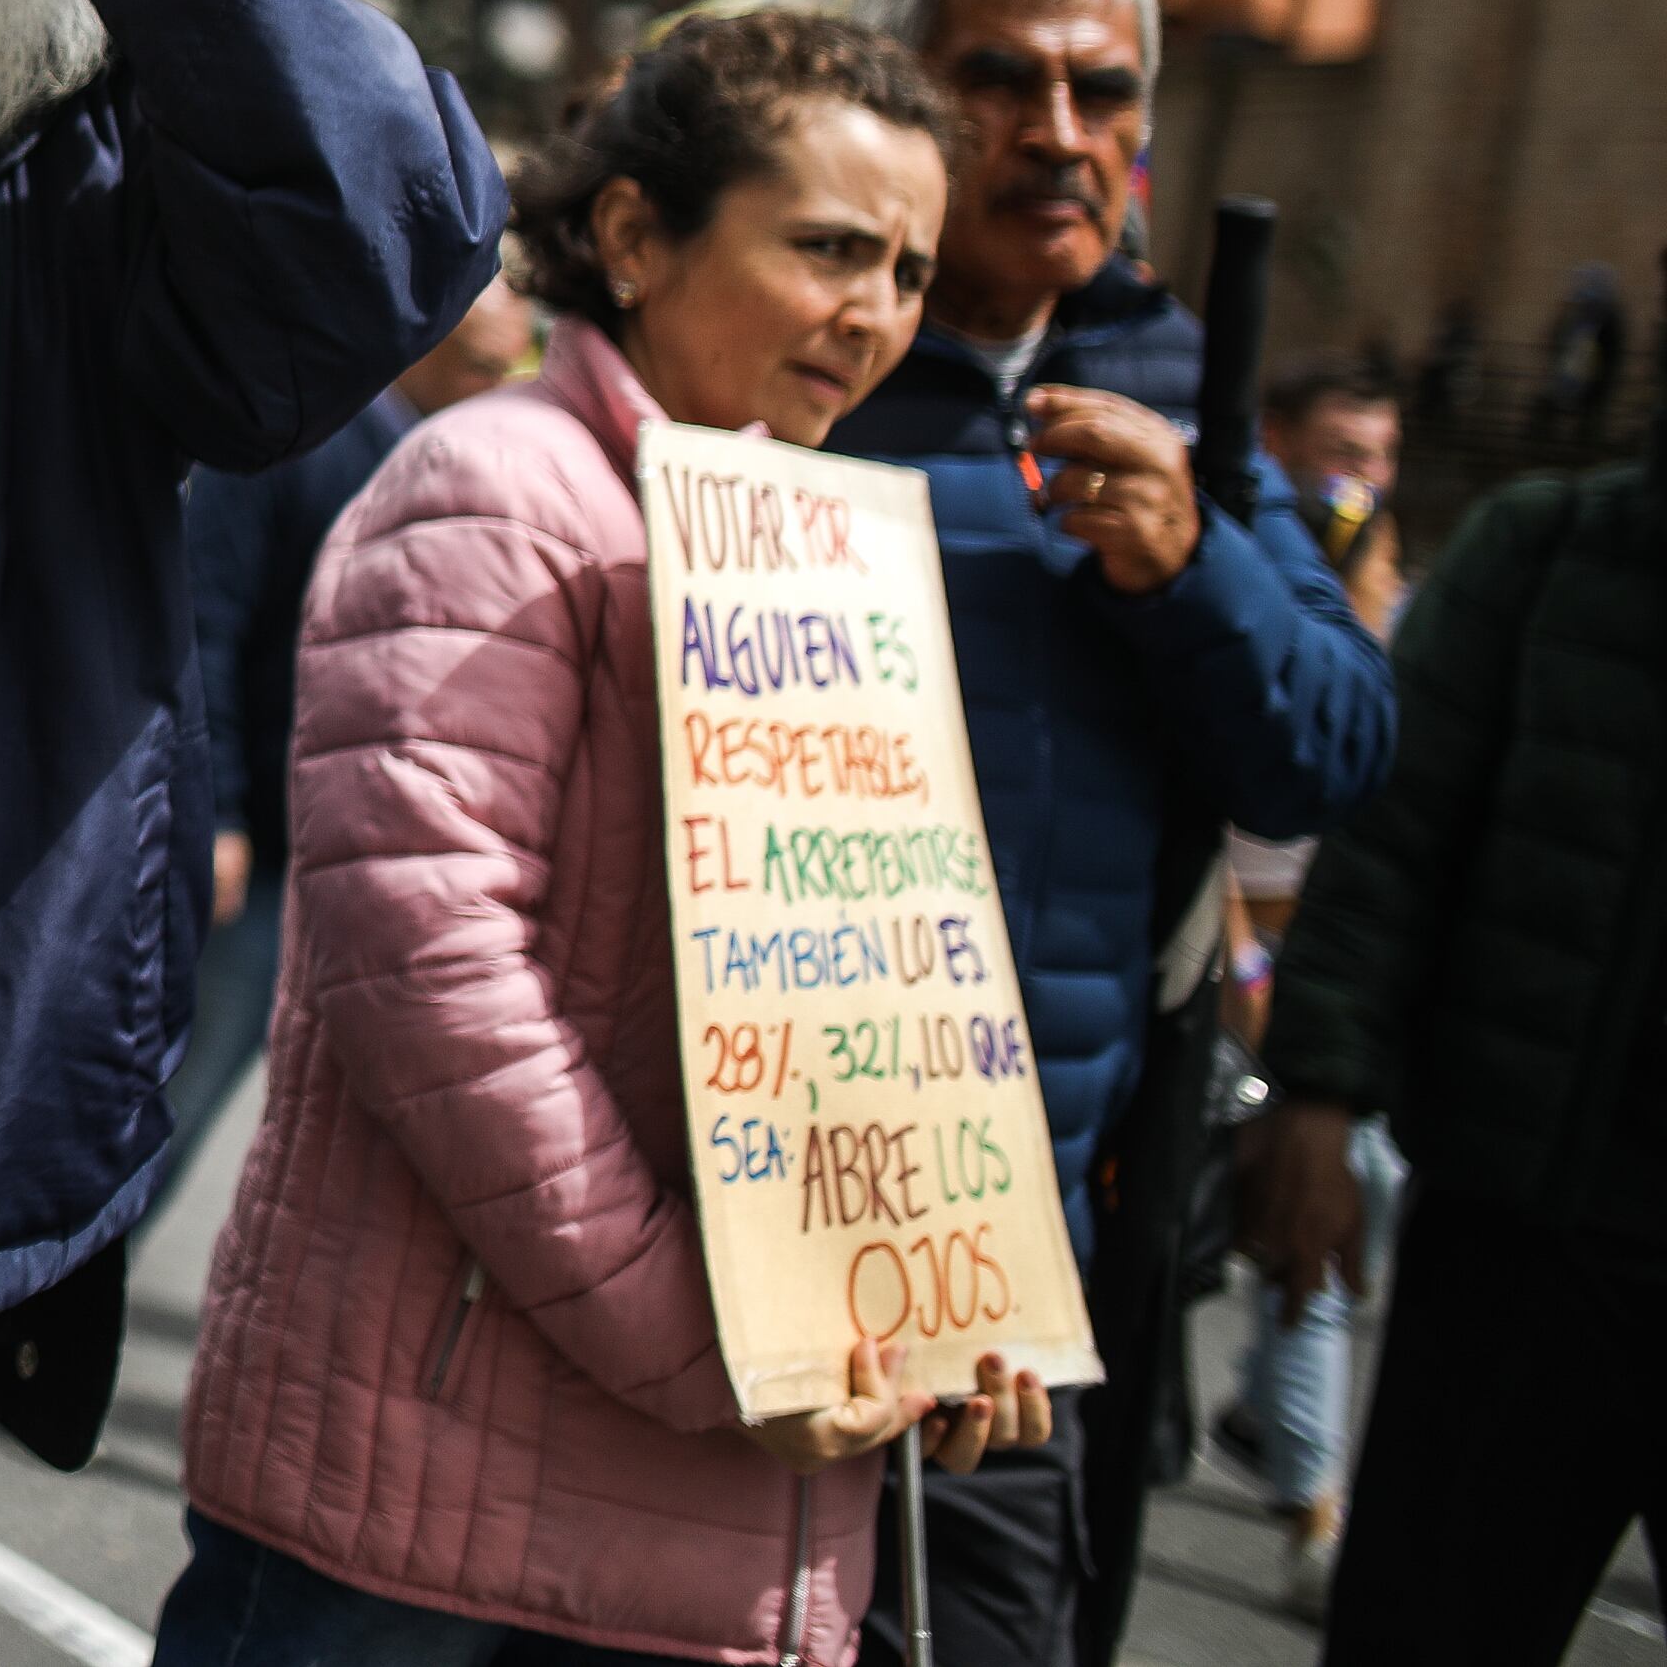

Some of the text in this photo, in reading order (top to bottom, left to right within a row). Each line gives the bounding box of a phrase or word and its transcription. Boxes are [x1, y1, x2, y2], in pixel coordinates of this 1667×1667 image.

[663, 464, 868, 575] VOTAR POR
[680, 596, 919, 696] ALGUIEN ES
[684, 709, 931, 807] RESPETABLE,
[682, 815, 750, 896] EL
[893, 914, 936, 987] LO
[920, 1013, 965, 1080] LO
[970, 1014, 1027, 1085] QUE
[710, 1114, 1013, 1233] SEA: ABRE LOS
